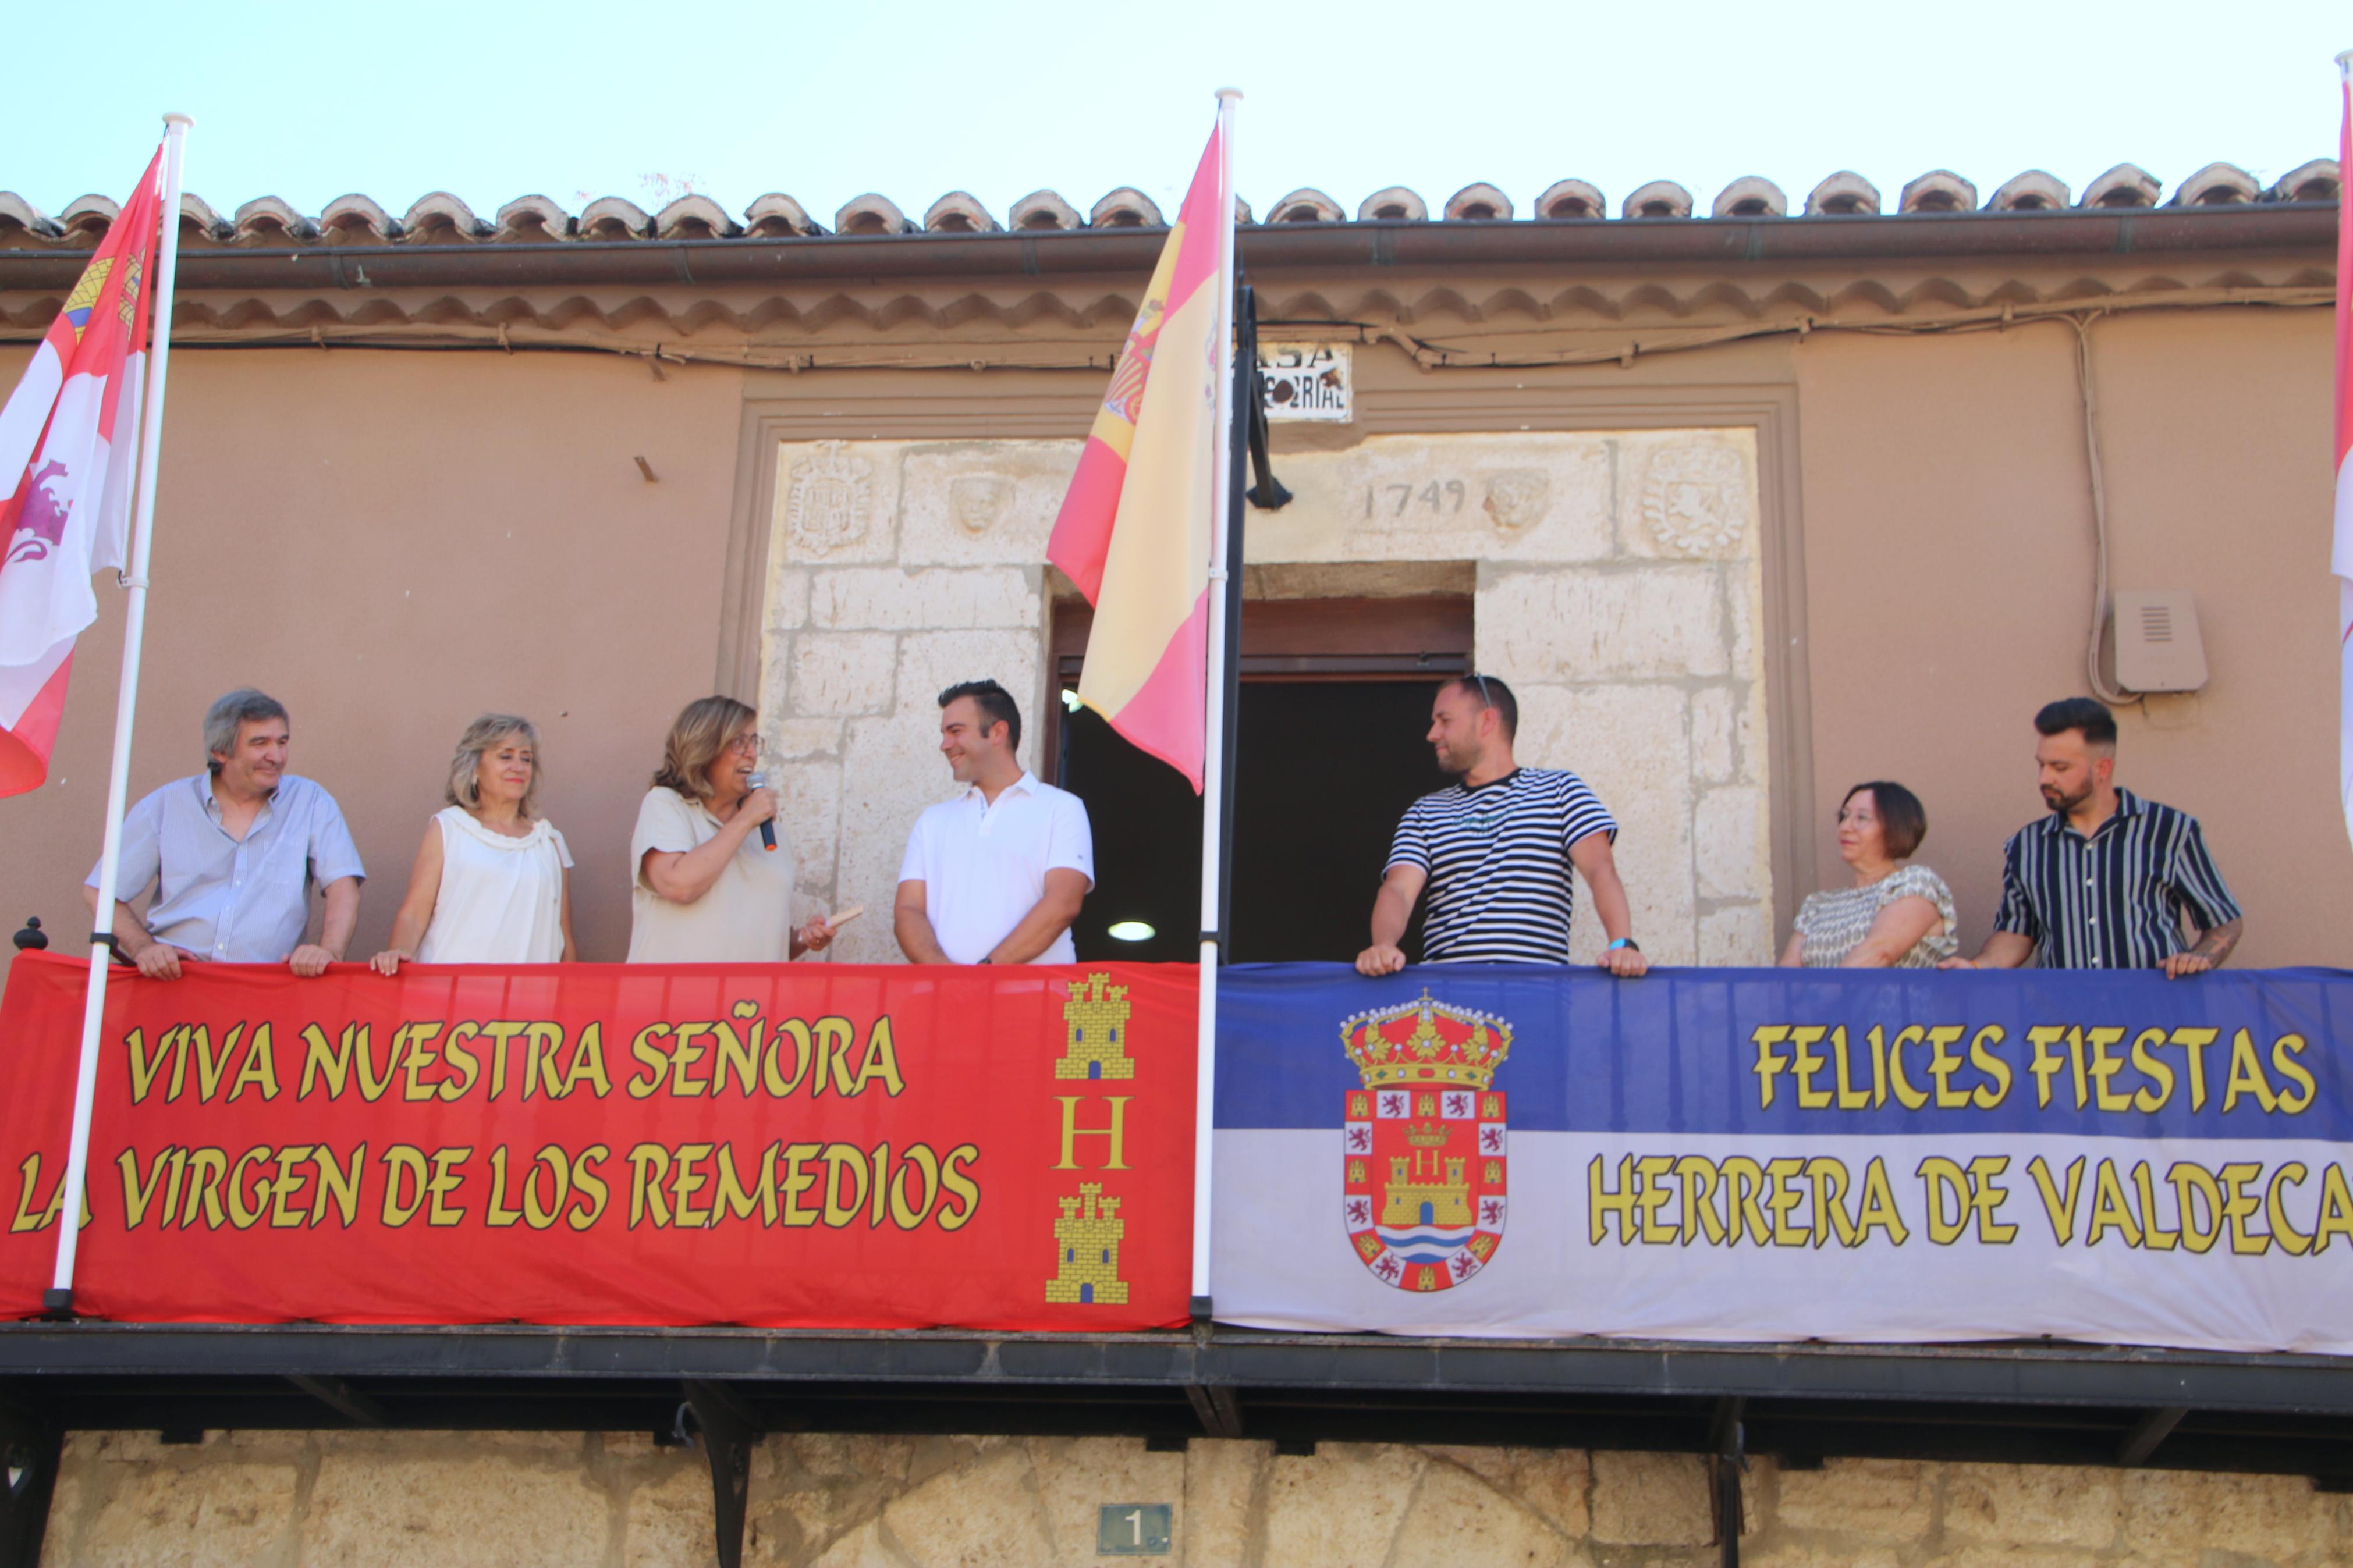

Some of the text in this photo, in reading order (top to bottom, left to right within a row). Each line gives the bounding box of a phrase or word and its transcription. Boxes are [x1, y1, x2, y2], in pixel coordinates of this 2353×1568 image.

[1365, 479, 1465, 518] 1749
[124, 1000, 906, 1105] VIVA NUESTRA SEÑORA
[1751, 1023, 2318, 1115] FELICES FIESTAS
[1049, 1096, 1135, 1170] H
[1415, 1149, 1440, 1176] H
[115, 1142, 367, 1231] VIRGEN
[379, 1143, 473, 1228] DE
[485, 1143, 611, 1232] LOS
[626, 1140, 981, 1232] REMEDIOS
[1587, 1153, 1910, 1249] HERRERA
[1916, 1155, 2019, 1246] DE
[1125, 1510, 1141, 1545] 1
